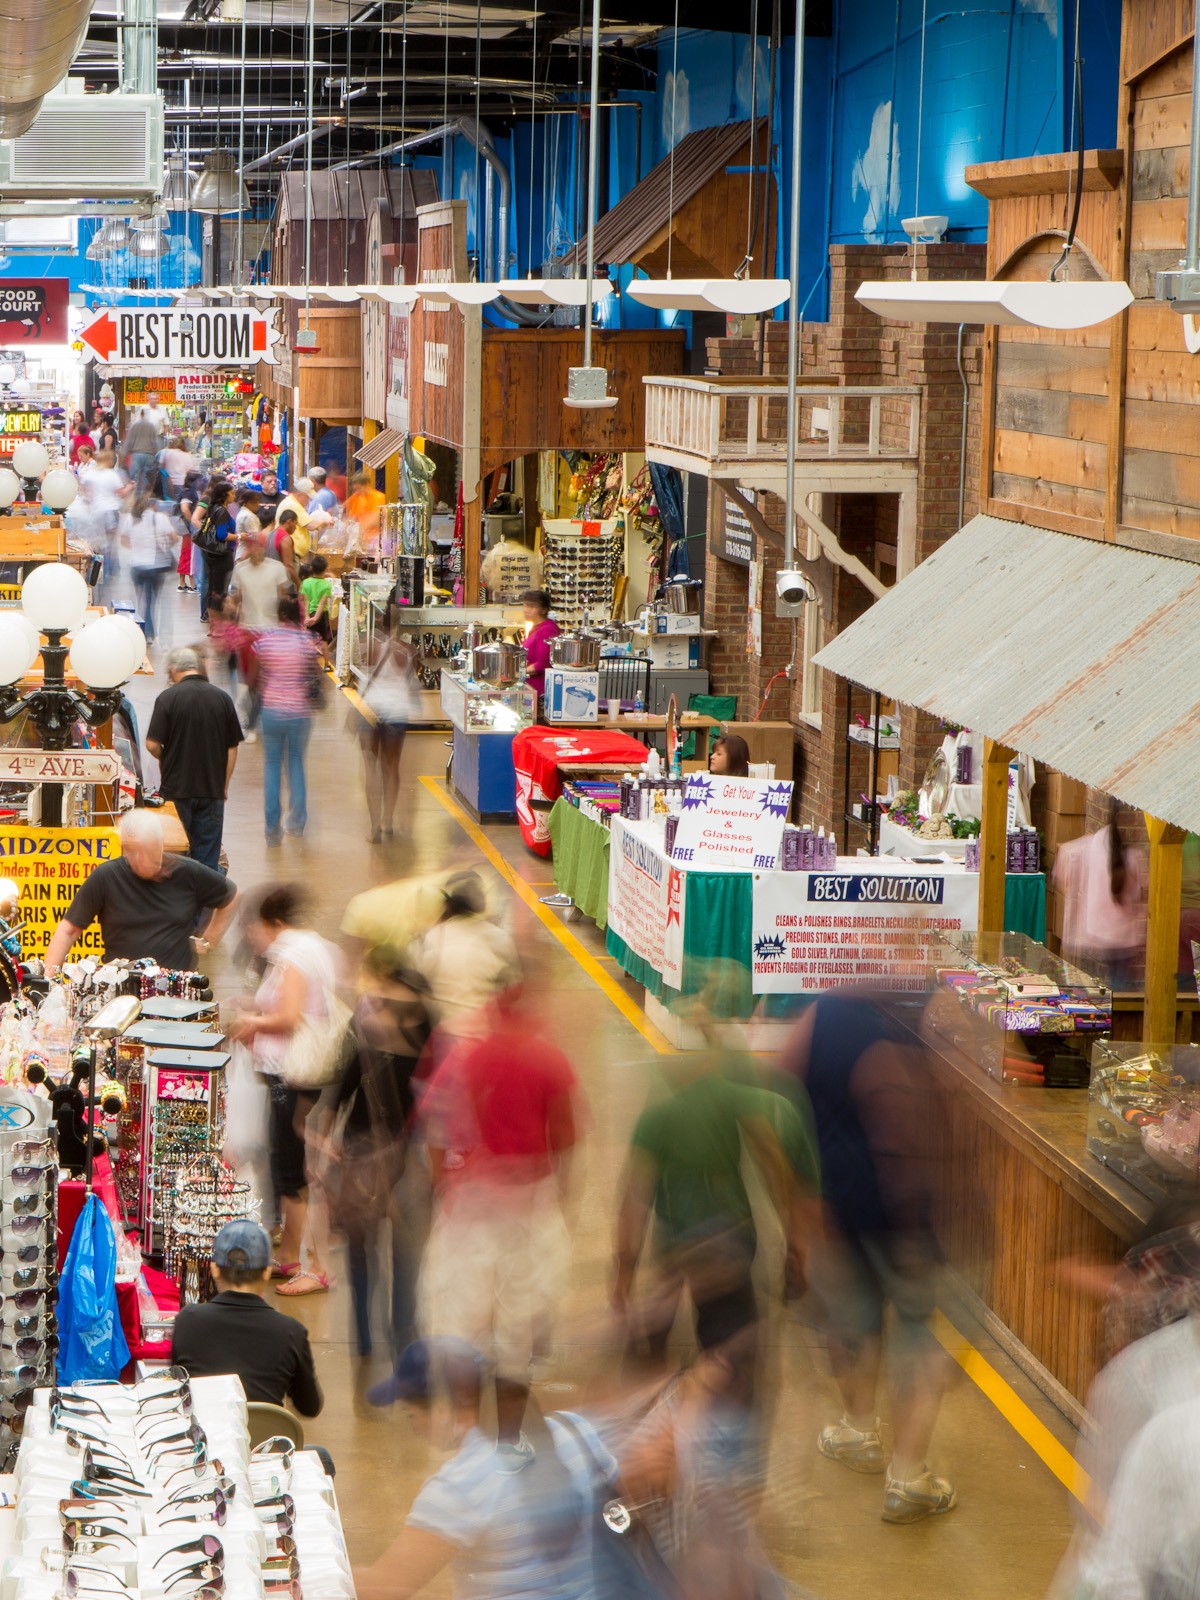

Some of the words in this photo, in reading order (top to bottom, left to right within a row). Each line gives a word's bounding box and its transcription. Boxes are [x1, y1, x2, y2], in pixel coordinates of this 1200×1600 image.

[120, 313, 250, 359] REST-ROOM
[143, 377, 176, 391] JUMB
[4, 413, 40, 432] JEWELRY
[589, 676, 597, 684] 10
[8, 756, 36, 775] 4TH
[38, 757, 91, 777] AVE.
[98, 763, 112, 773] W
[685, 786, 709, 800] FREE
[722, 784, 737, 799] Get
[737, 786, 756, 800] Your
[767, 791, 791, 807] FREE
[705, 806, 762, 821] Jewelery
[724, 820, 733, 829] &
[702, 829, 753, 842] Glasses
[699, 841, 754, 854] Polished
[672, 847, 695, 861] FREE
[753, 854, 776, 869] FREE
[33, 861, 56, 878] The
[58, 862, 80, 878] BIG
[83, 863, 98, 879] TO
[17, 883, 51, 901] AIN
[813, 876, 853, 901] BEST
[858, 876, 941, 902] SOLUTION
[775, 915, 798, 927] CLEANS
[798, 917, 803, 927] &
[804, 915, 833, 927] POLISHES
[785, 931, 815, 943] PRECIOUS
[816, 932, 839, 945] STONES,
[791, 947, 806, 959] GOLD
[807, 947, 828, 960] SILVER,
[829, 948, 860, 960] PLATINUM,
[888, 950, 893, 960] &
[754, 962, 781, 974] PREVENTS
[782, 962, 808, 974] FOGGING
[809, 962, 817, 974] OF
[817, 962, 854, 975] EYEGLASSES,
[855, 962, 883, 974] MIRRORS
[883, 965, 889, 974] &
[801, 977, 818, 989] 100%
[819, 977, 839, 989] MONEY
[891, 979, 907, 991] BEST
